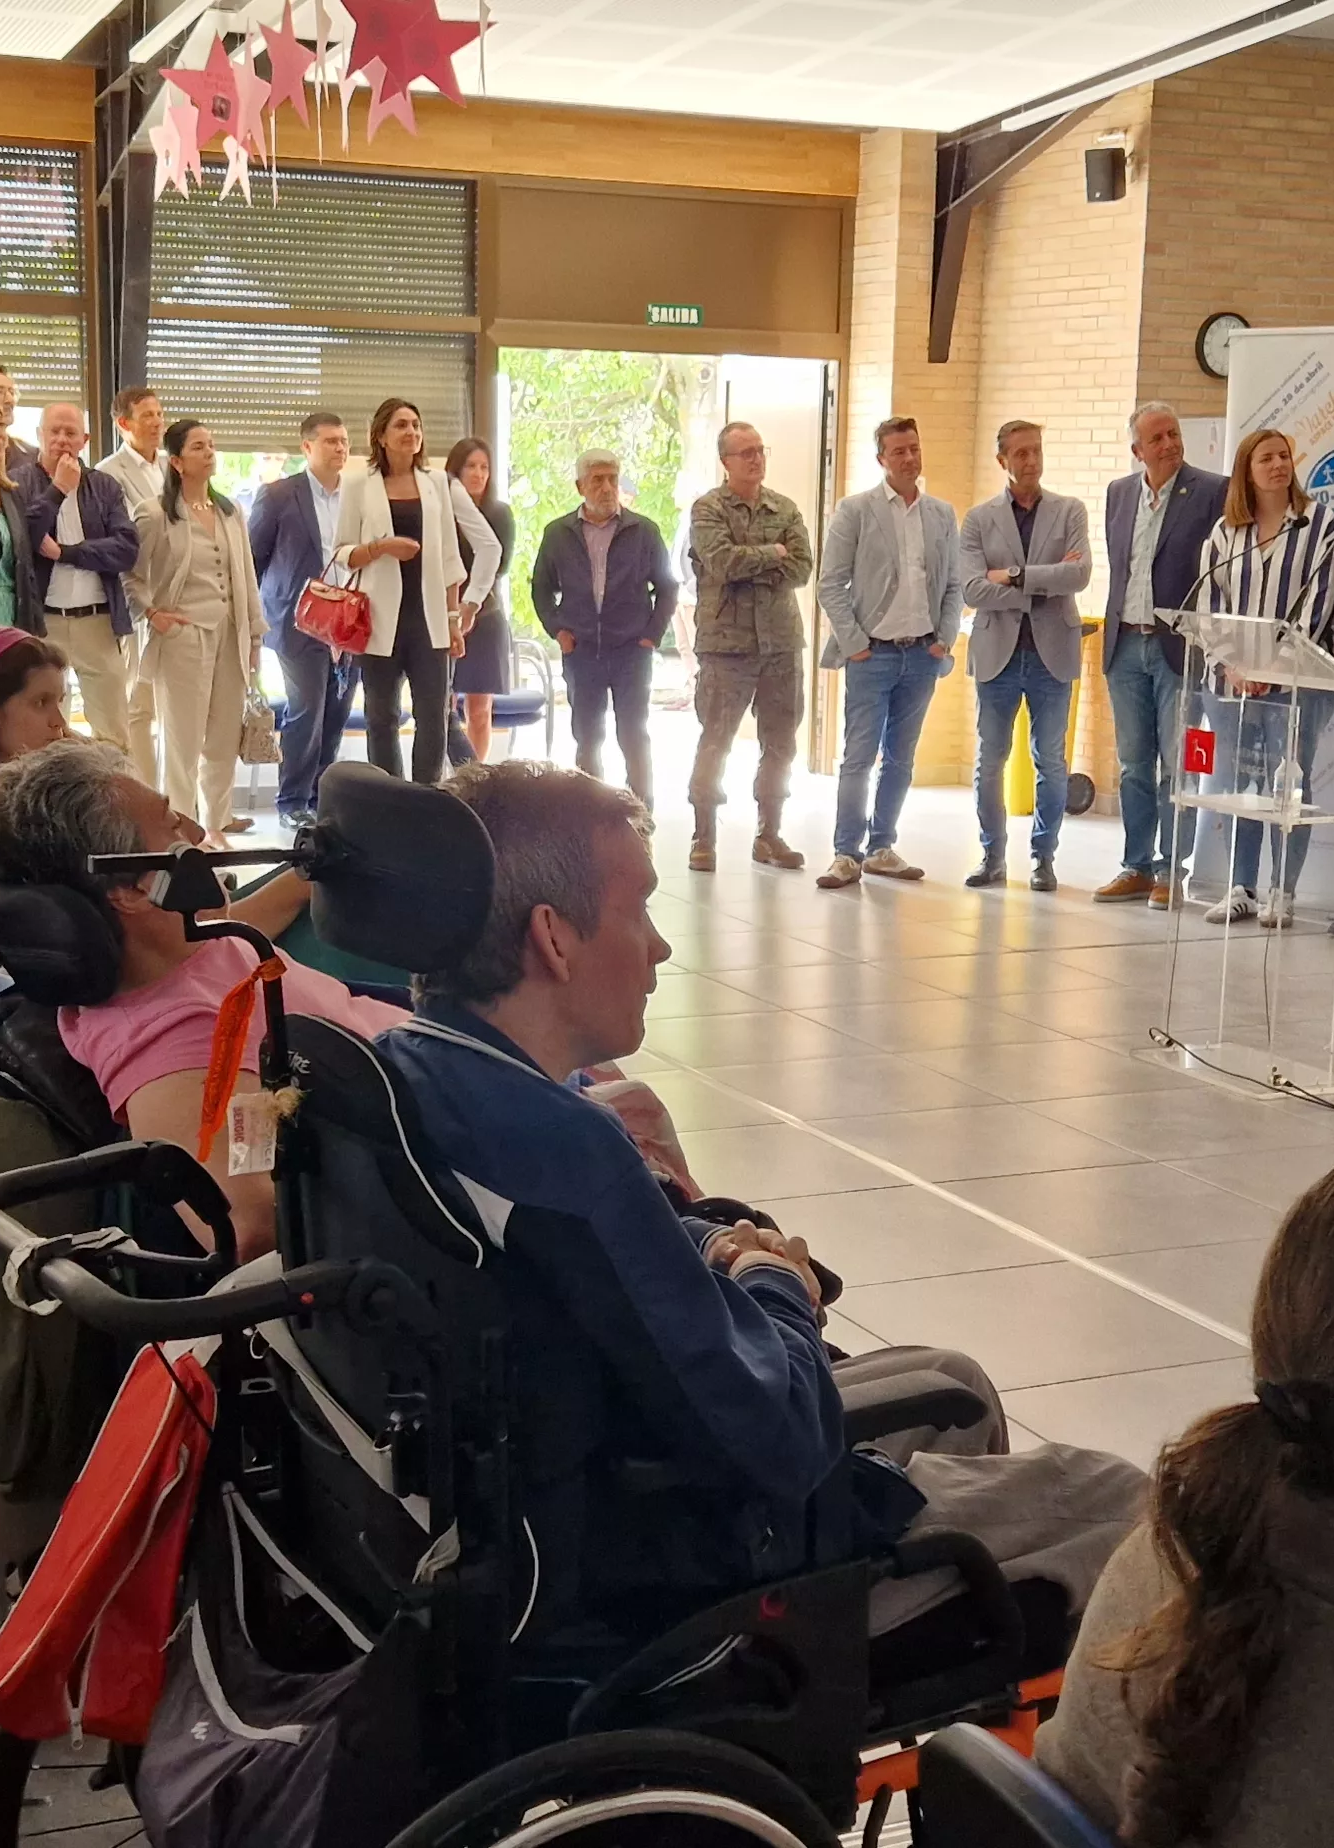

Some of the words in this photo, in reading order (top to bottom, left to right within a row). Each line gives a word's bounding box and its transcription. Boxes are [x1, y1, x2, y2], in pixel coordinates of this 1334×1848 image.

[651, 306, 699, 325] SALIDA
[1255, 407, 1283, 432] mingo,
[1294, 382, 1305, 394] de
[1305, 361, 1324, 383] abril
